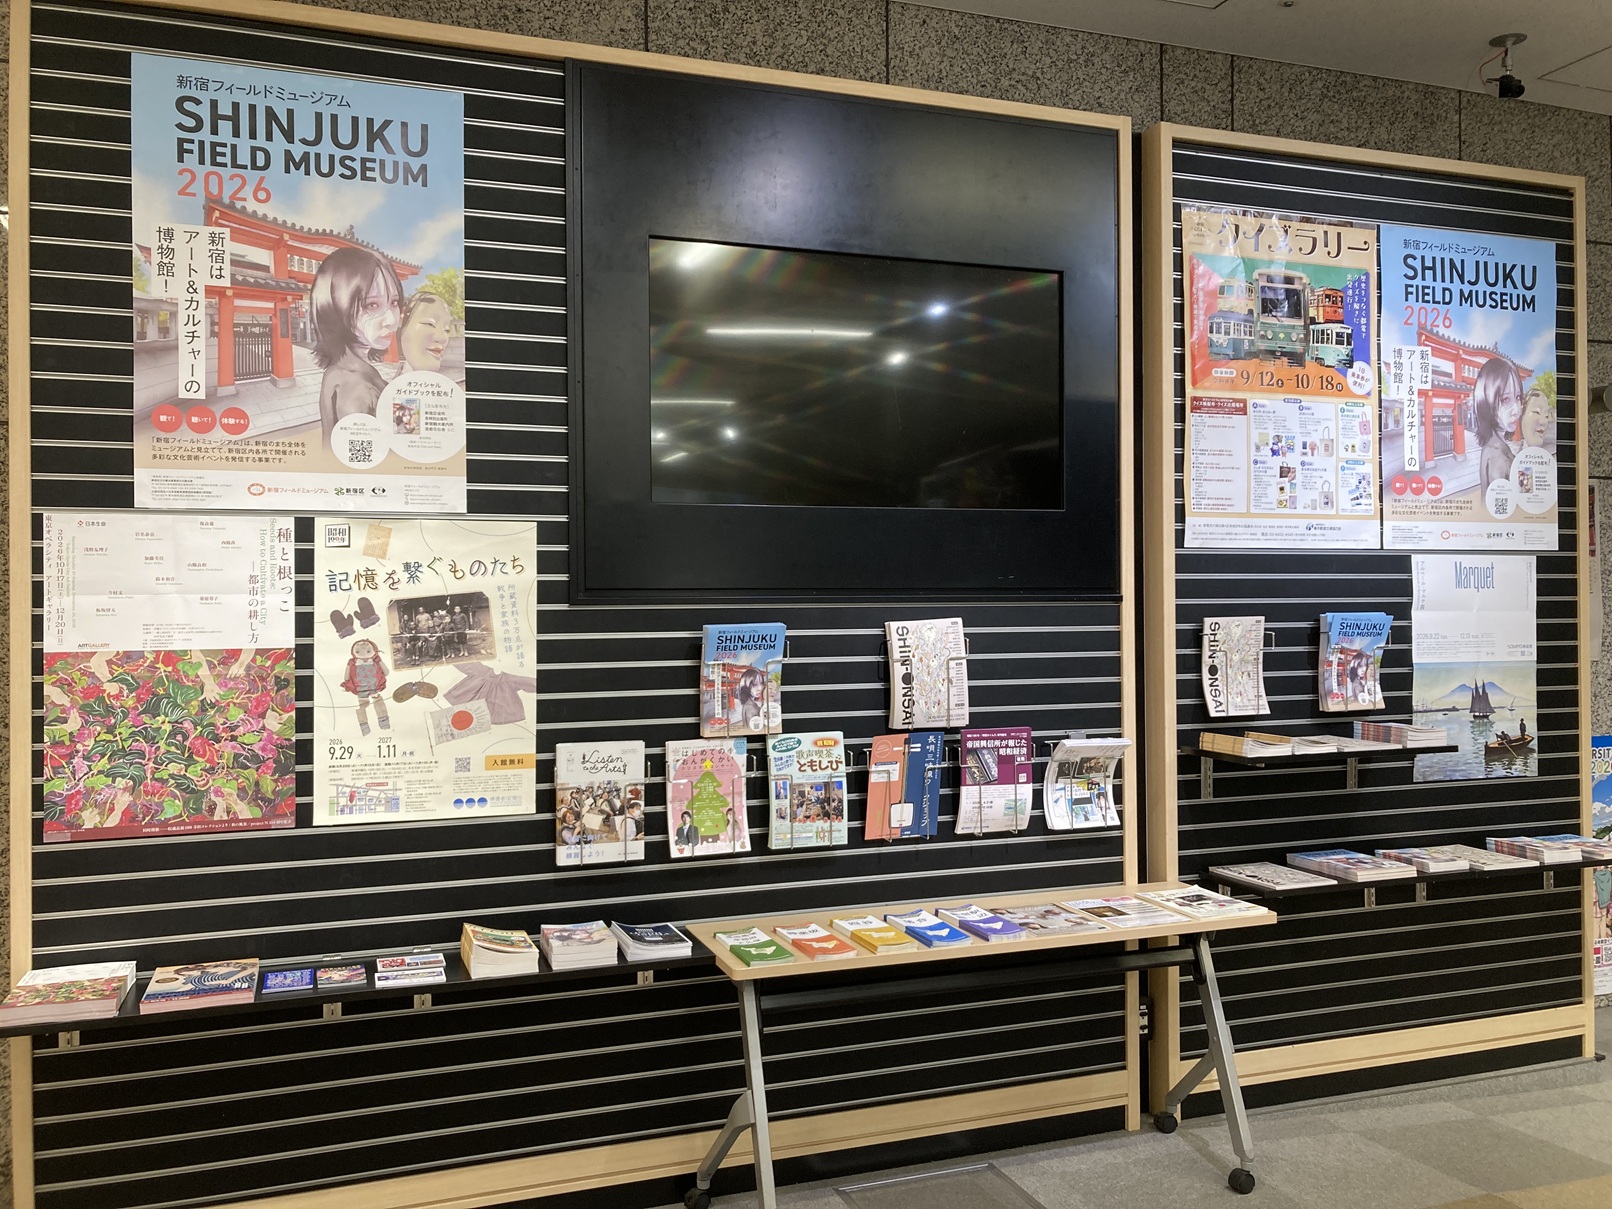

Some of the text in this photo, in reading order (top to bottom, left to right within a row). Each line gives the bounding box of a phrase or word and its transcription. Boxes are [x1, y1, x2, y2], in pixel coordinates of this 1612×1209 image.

[176, 74, 351, 108] 新宿フィールドミュージアム
[174, 95, 429, 158] SHINJUKU
[176, 137, 428, 188] FIELD MUSEUM
[177, 167, 272, 204] 2026
[208, 231, 226, 279] 新宿は
[1403, 238, 1495, 257] 新宿フィールドミュージアム
[157, 226, 175, 293] 博物館!
[1403, 253, 1537, 291] SHINJUKU
[1404, 283, 1536, 313] FIELD MUSEUM
[183, 230, 201, 394] アート&カルチャーの
[1403, 305, 1453, 329] 2026
[1420, 349, 1430, 385] 新宿は
[396, 388, 454, 398] ガイドブックを配布!
[1406, 349, 1417, 467] アート&カルチャーの
[221, 417, 248, 425] 体験する!
[151, 436, 307, 448] 「新宿フィールドミュージアム」は、新宿のまち全体を
[151, 445, 307, 456] ミュージアムと見立てて、新宿区内各所で開催される
[151, 454, 287, 464] 多彩な文化芸術イベントを発信する事業です。
[267, 487, 329, 495] 新宿フィールドミュージアム
[327, 527, 347, 537] 昭和
[260, 548, 267, 558] to
[45, 514, 53, 631] 東京オペラシティ アートギャラリー
[276, 527, 293, 612] 種と根っこ
[325, 555, 525, 592] 記憶を繋ぐものたち
[1455, 561, 1495, 593] Marquet
[260, 559, 268, 599] Cultivate
[260, 607, 268, 625] City
[496, 585, 513, 653] 戦争と家族の物語
[1339, 622, 1385, 631] SHINJUKU
[716, 643, 776, 652] FIELD MUSEUM
[717, 634, 777, 645] SHINJUKU
[377, 744, 397, 758] 1.11
[966, 739, 1027, 748] 帝国興信所が報じた
[328, 746, 354, 760] 9.29
[583, 750, 623, 764] Listen
[682, 748, 726, 756] はじめての
[796, 749, 834, 759] 歌声喫茶
[999, 748, 1027, 756] 昭和経済
[492, 758, 524, 766] 入館無料
[797, 759, 843, 773] ともしび
